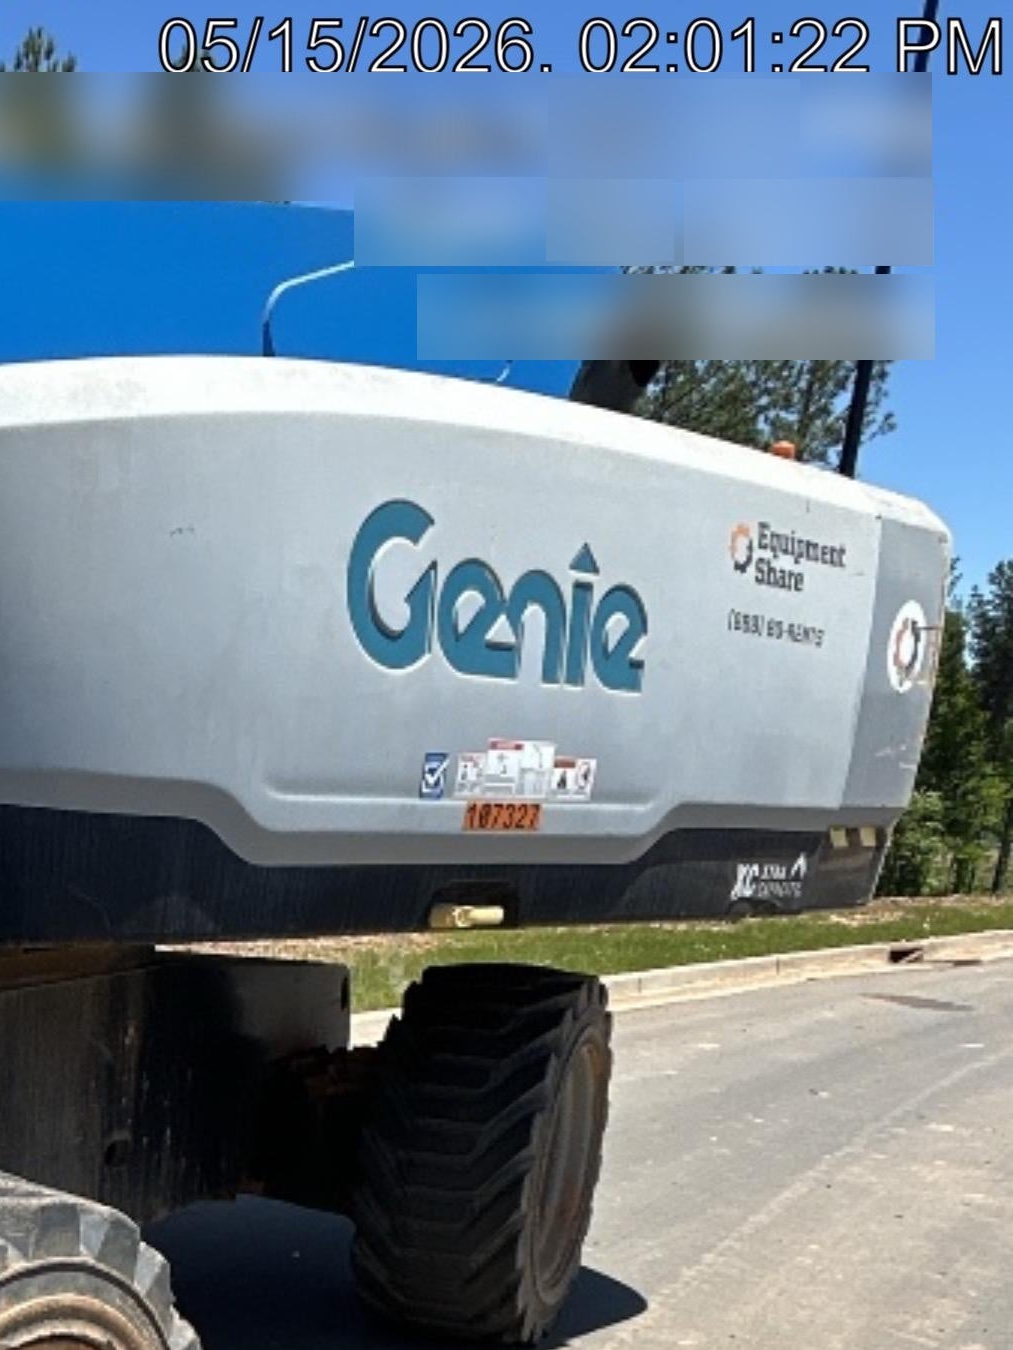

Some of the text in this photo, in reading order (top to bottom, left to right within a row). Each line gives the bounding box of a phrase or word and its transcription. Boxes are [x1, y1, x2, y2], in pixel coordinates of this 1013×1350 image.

[756, 521, 846, 568] Equipment
[754, 557, 805, 592] Share
[346, 497, 649, 694] Genie
[467, 802, 542, 830] 107327
